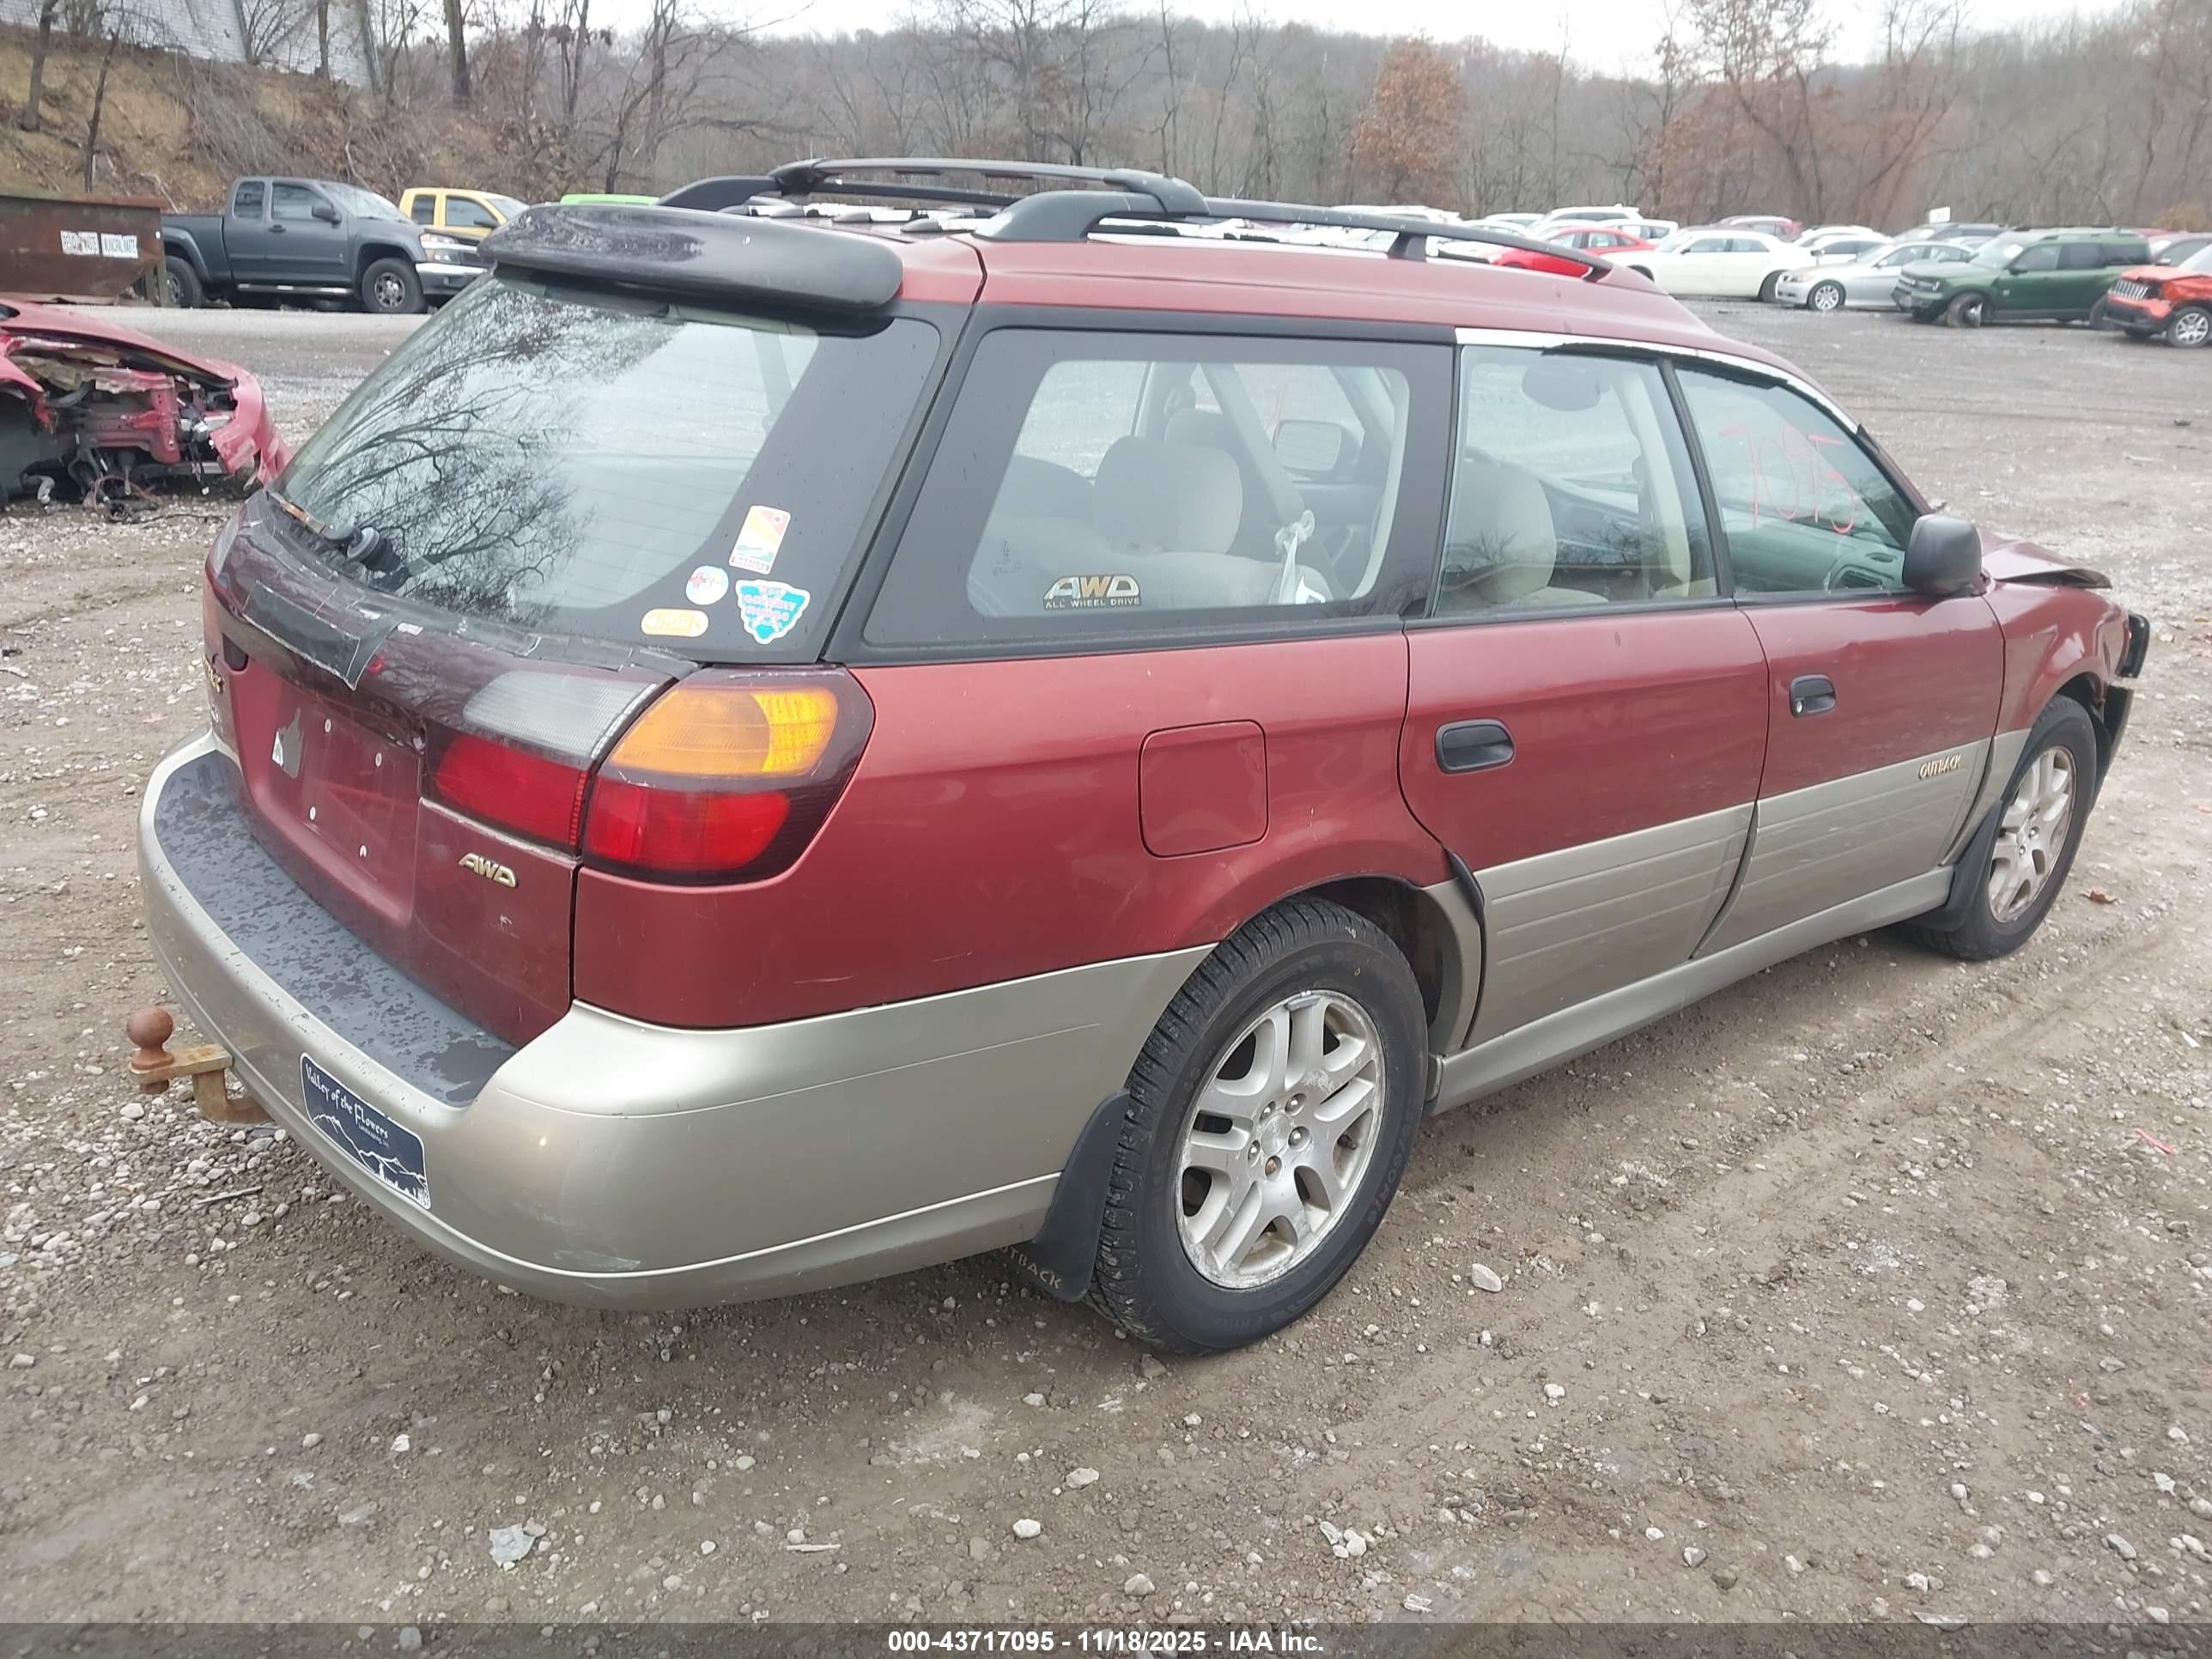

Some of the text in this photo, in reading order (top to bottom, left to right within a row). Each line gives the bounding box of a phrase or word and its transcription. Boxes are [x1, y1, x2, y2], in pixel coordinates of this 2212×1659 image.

[1043, 575, 1140, 599] AWD
[1045, 597, 1140, 610] ALL WHEEL DRIVE
[1919, 753, 1961, 779] OUTBACK
[458, 853, 517, 888] AWD
[306, 1063, 389, 1139] Valley of the Flowers
[1000, 1245, 1062, 1290] UTBACK
